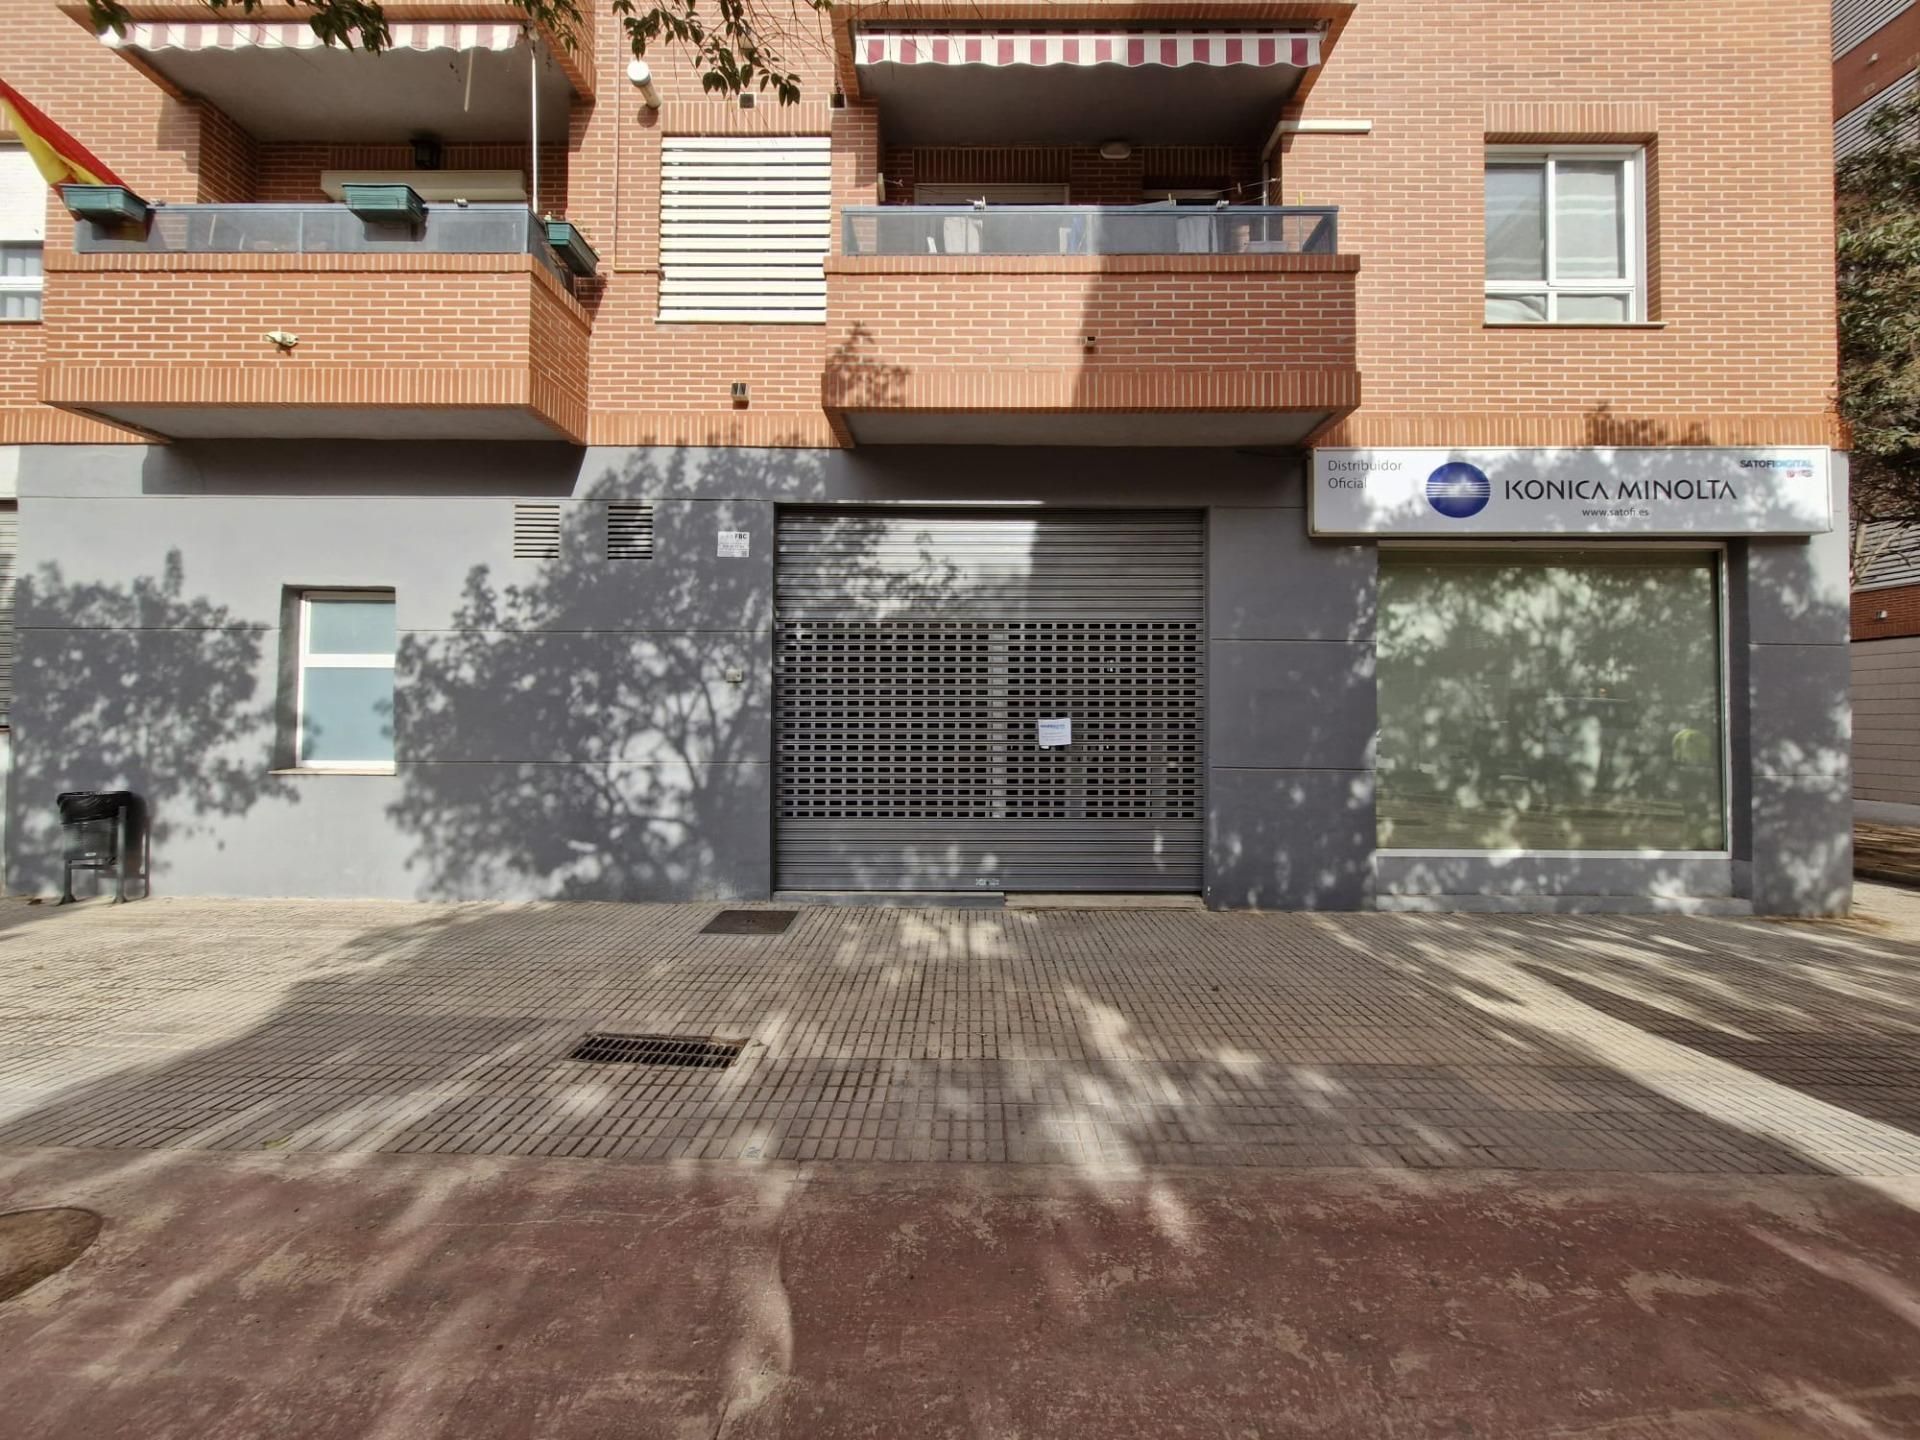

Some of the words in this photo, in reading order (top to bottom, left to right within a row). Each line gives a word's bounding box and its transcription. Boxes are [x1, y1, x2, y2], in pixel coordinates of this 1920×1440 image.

[1328, 460, 1402, 471] Distribuidor
[1328, 477, 1367, 489] Oficial
[1505, 480, 1609, 500] KONICA
[1617, 480, 1738, 500] MINOLTA
[1582, 507, 1649, 517] www.satofies
